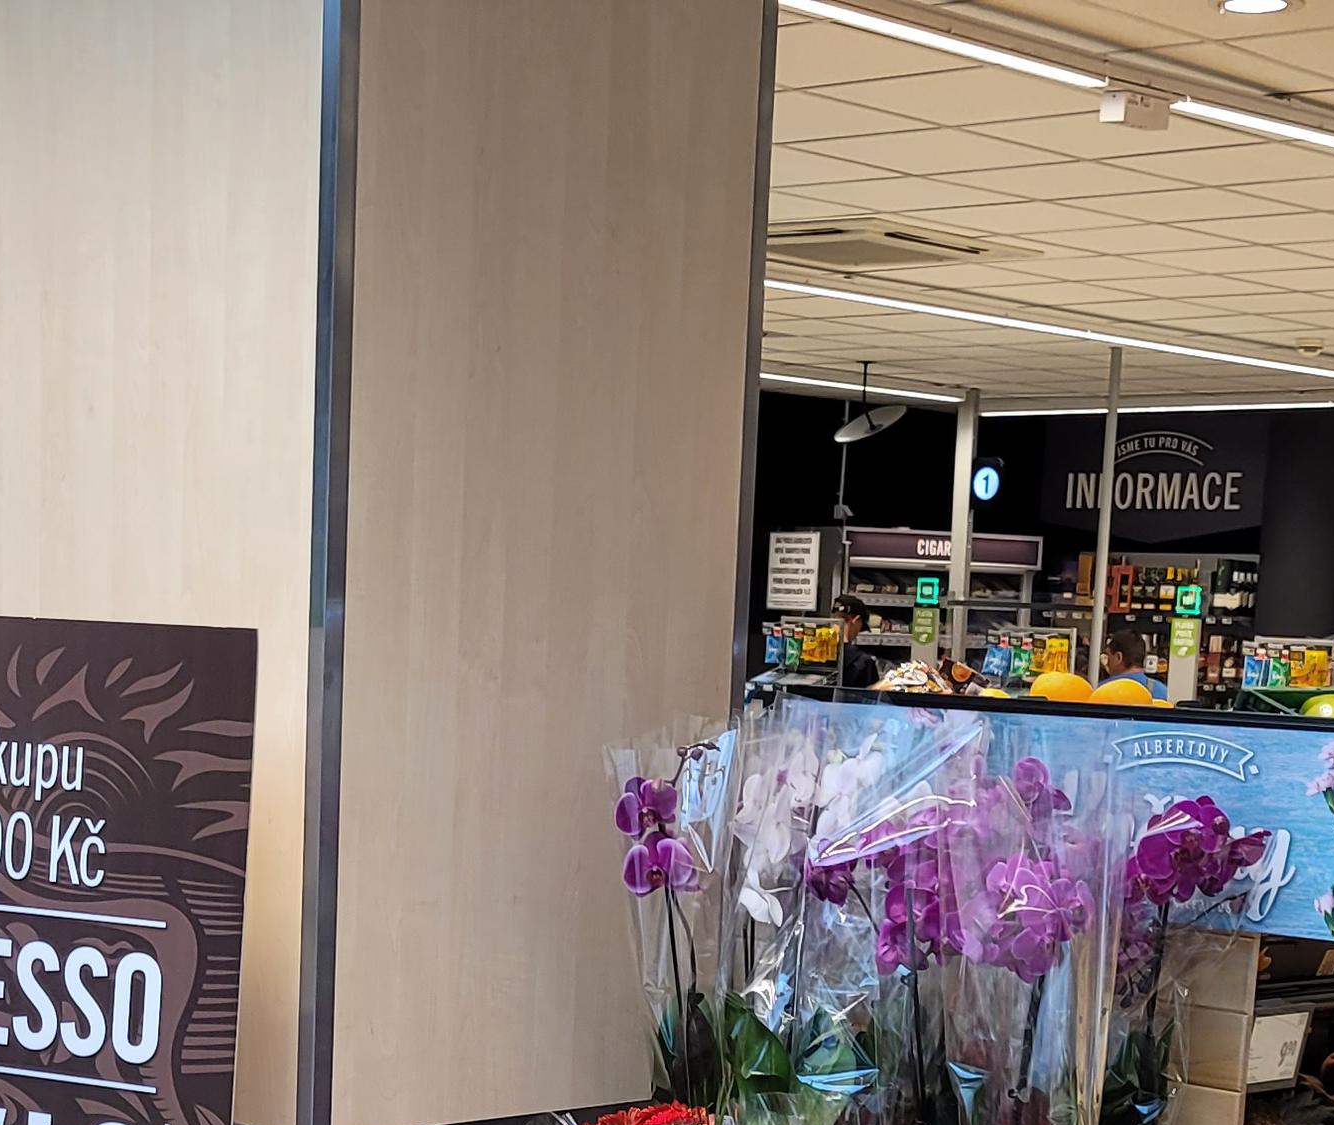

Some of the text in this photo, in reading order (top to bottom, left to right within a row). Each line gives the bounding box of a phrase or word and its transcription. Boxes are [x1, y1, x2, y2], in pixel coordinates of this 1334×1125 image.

[1143, 437, 1156, 449] TU
[1158, 436, 1178, 449] PRO
[1181, 439, 1200, 457] VÁS
[1065, 471, 1244, 511] INORMACE
[1133, 738, 1230, 764] ALBERTOVY
[48, 814, 107, 888] Kč
